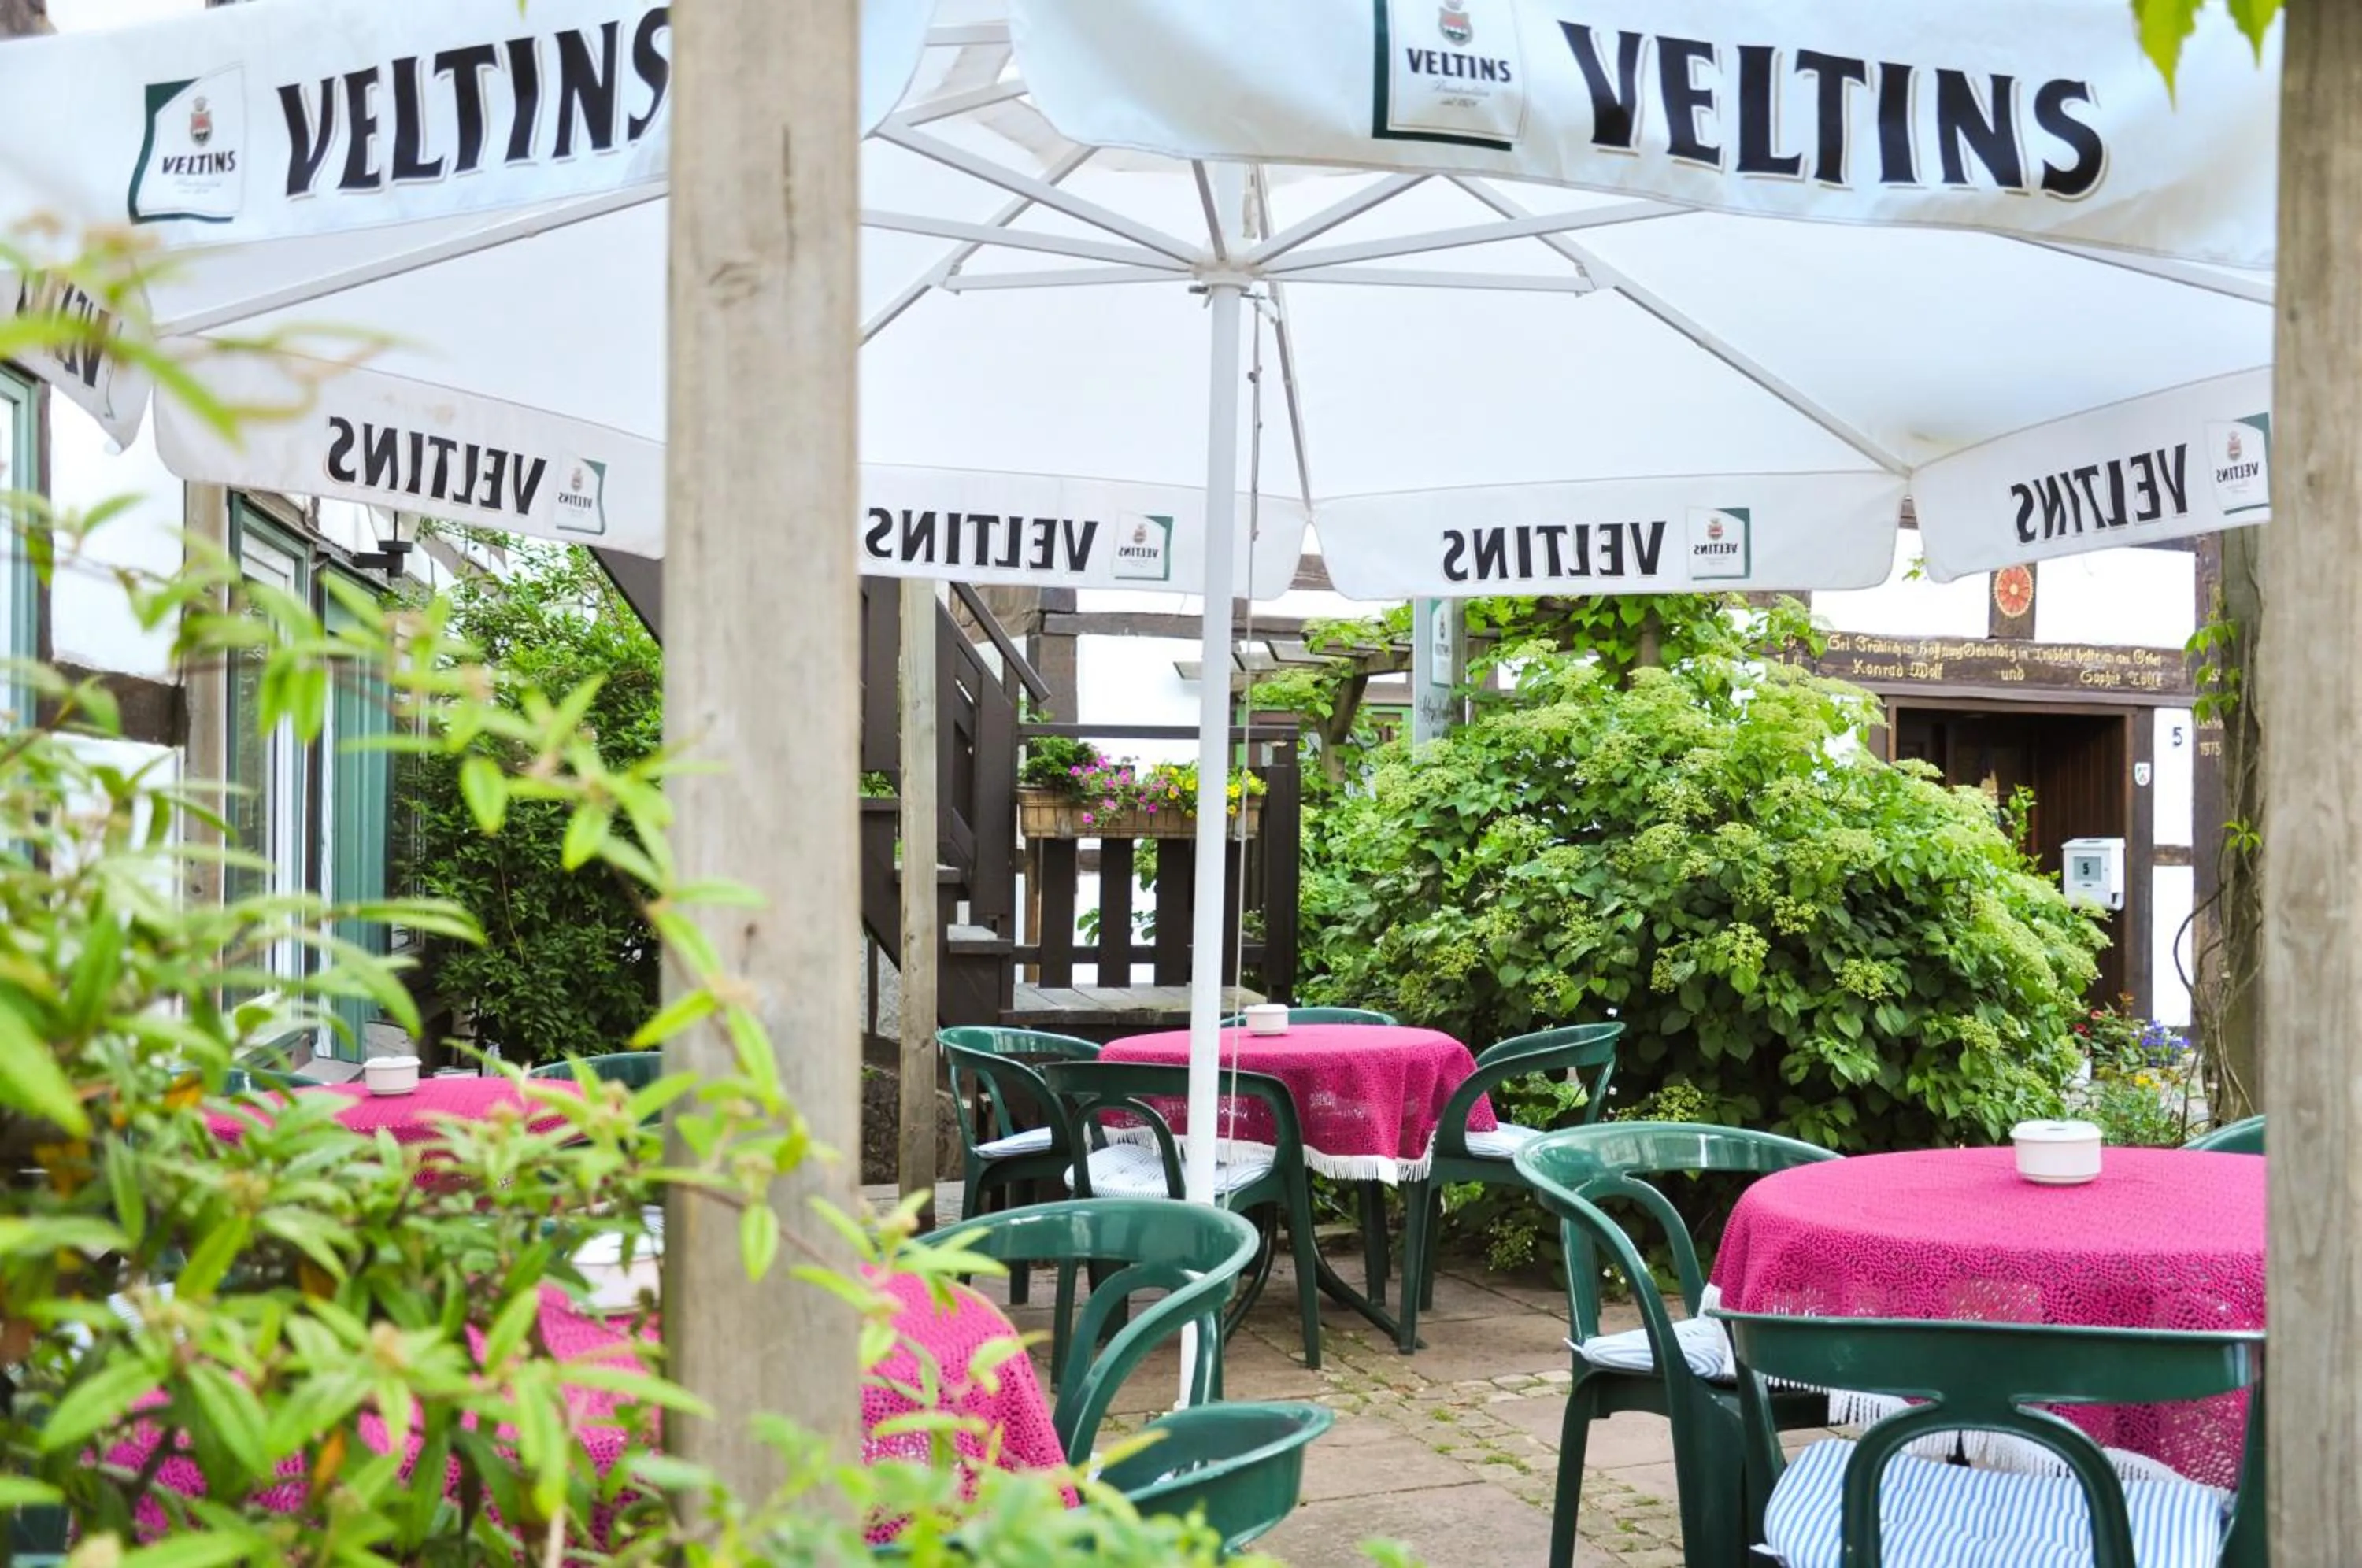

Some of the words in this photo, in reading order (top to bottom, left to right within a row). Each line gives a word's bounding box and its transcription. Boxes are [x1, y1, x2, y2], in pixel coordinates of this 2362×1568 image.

[1406, 48, 1512, 83] VELTINS
[276, 6, 671, 198] VELTINS
[1557, 19, 2107, 197] VELTINS
[161, 150, 236, 175] VELTINS
[1852, 658, 1903, 677] Konrad
[2001, 664, 2025, 681] und
[2172, 727, 2183, 747] 5
